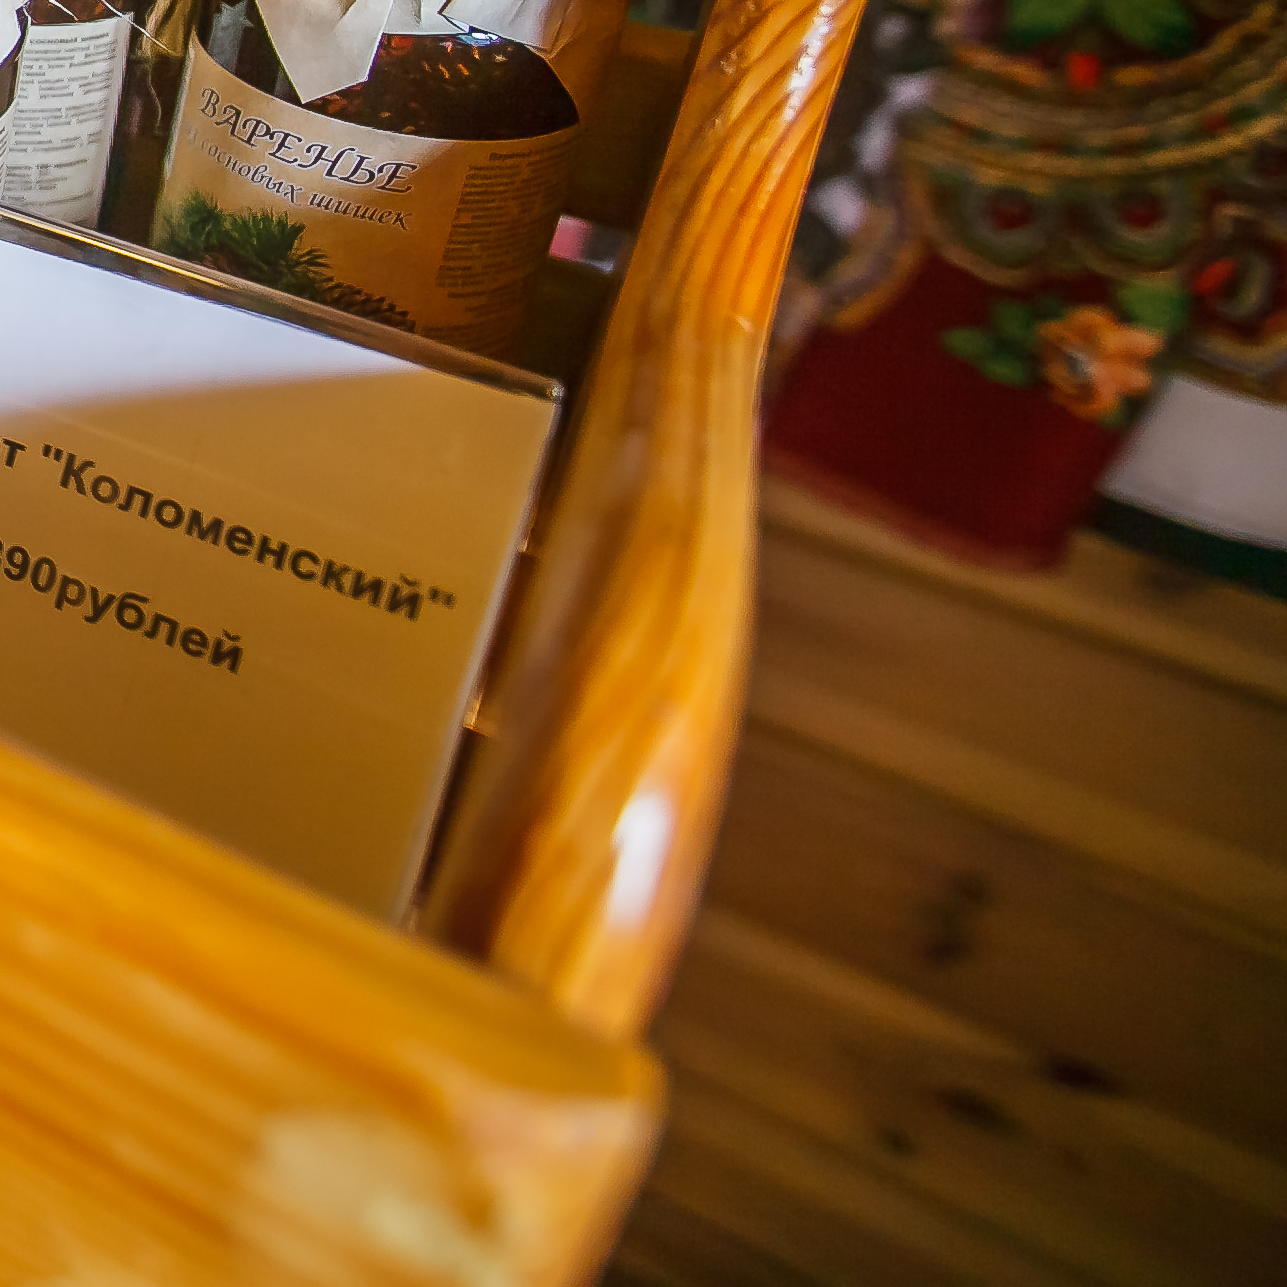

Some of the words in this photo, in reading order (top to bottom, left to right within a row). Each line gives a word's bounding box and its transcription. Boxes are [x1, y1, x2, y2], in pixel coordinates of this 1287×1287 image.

[200, 87, 419, 193] ВАРЕНЬЕ
[201, 139, 303, 207] сосновых
[308, 191, 415, 232] шишек
[41, 443, 457, 622] "Коломенский"
